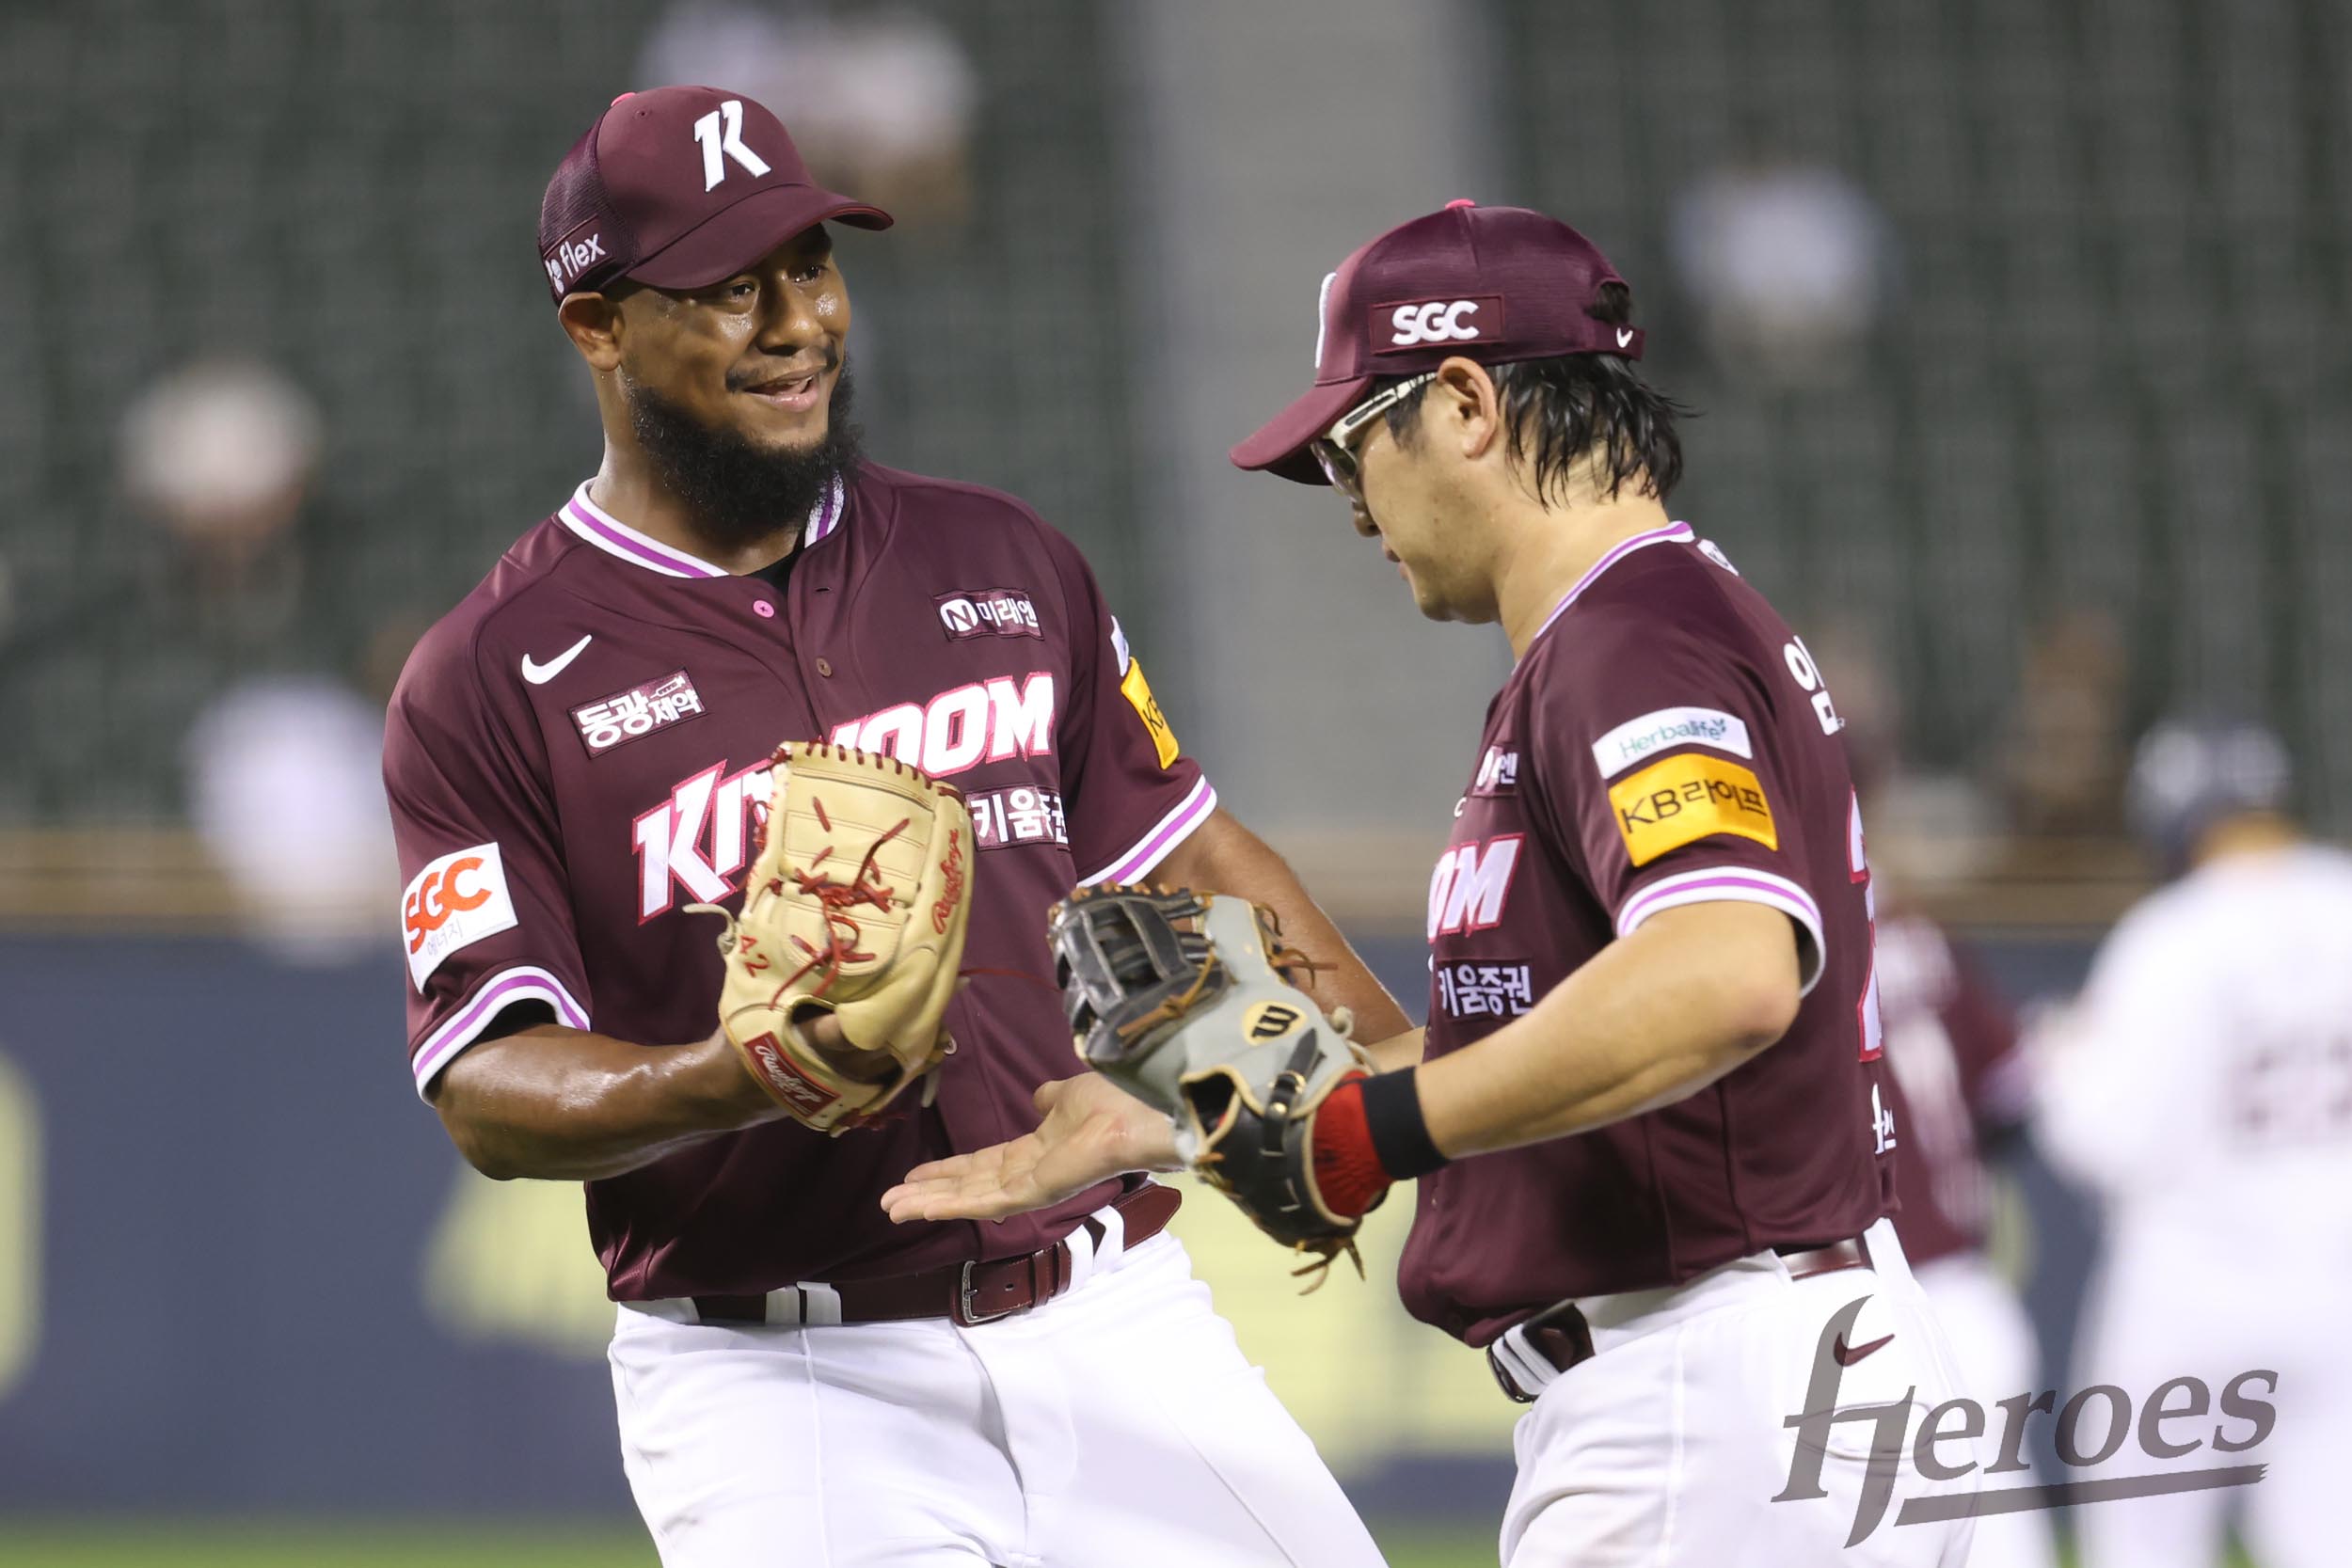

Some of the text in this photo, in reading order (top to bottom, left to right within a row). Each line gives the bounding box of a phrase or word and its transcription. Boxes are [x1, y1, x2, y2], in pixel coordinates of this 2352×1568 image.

[560, 232, 607, 278] flex
[1391, 300, 1479, 345] SGC
[577, 689, 702, 749] 동광제약
[1620, 719, 1722, 759] Herbalife
[1620, 779, 1767, 834] KB라이프
[405, 856, 493, 955] SGC
[1438, 964, 1534, 1017] 키움증권
